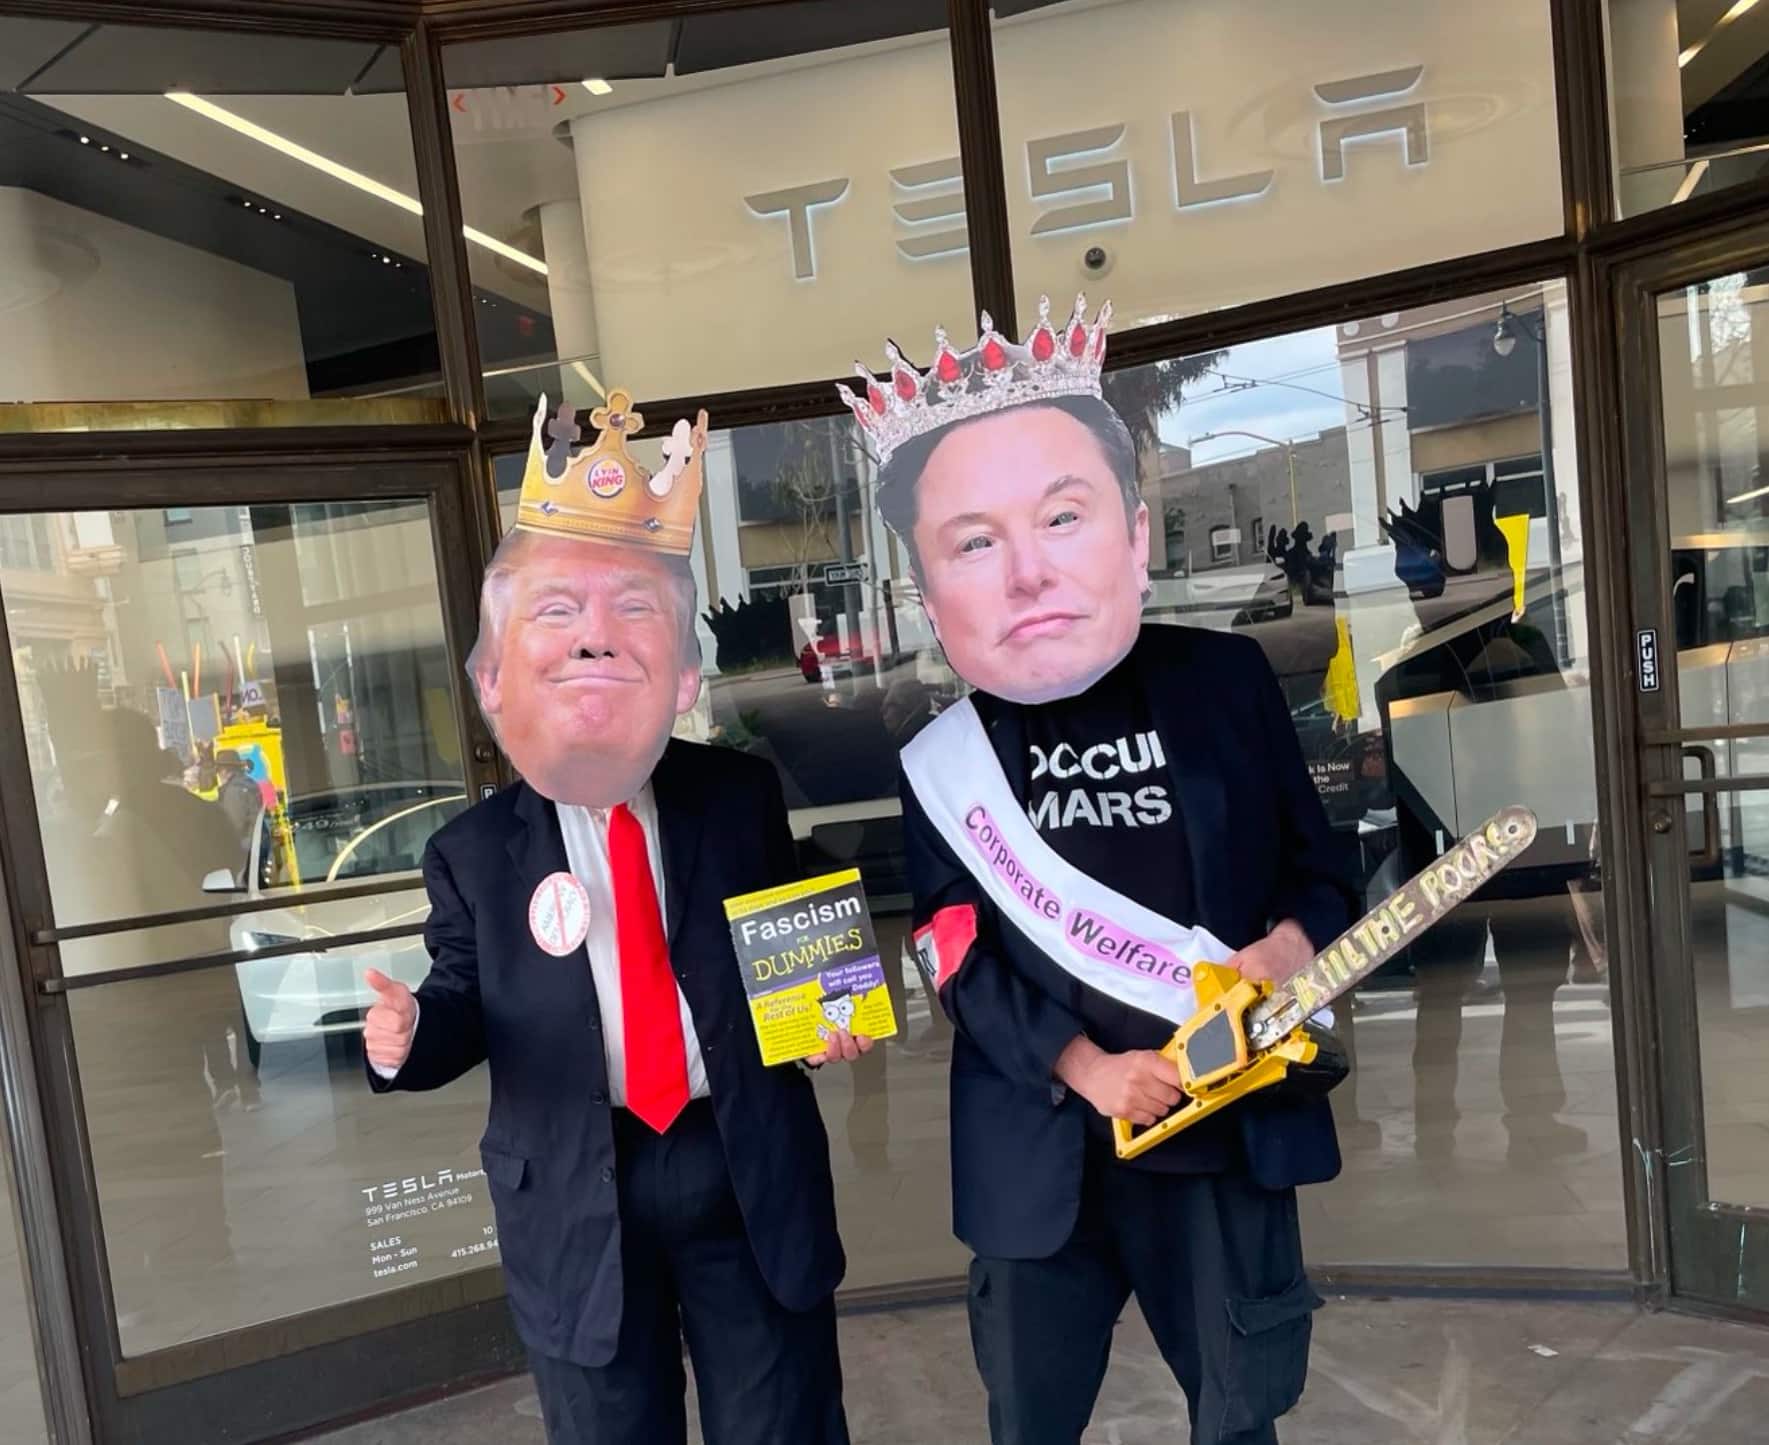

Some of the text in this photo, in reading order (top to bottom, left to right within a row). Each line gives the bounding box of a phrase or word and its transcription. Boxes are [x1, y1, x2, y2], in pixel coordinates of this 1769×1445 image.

[743, 64, 1430, 281] TESLA
[592, 475, 623, 488] KING
[1641, 634, 1655, 688] PUSH
[1313, 775, 1330, 785] the
[1328, 762, 1350, 772] Now
[1318, 783, 1349, 794] Credit
[1027, 785, 1173, 830] MARS
[965, 804, 1192, 985] Corporate Welfare
[740, 896, 862, 945] Fascism
[1356, 893, 1424, 956] THE
[751, 927, 864, 981] DUMMIES
[361, 1169, 453, 1202] TESLA
[365, 1187, 460, 1217] 999 Van Ness Avenue
[367, 1217, 384, 1228] San
[431, 1200, 445, 1211] CA
[446, 1193, 473, 1208] 94109
[370, 1236, 401, 1251] SALES
[482, 1225, 494, 1236] 10
[372, 1252, 393, 1265] Mon
[400, 1246, 418, 1259] Sun
[373, 1260, 418, 1278] tesla.com
